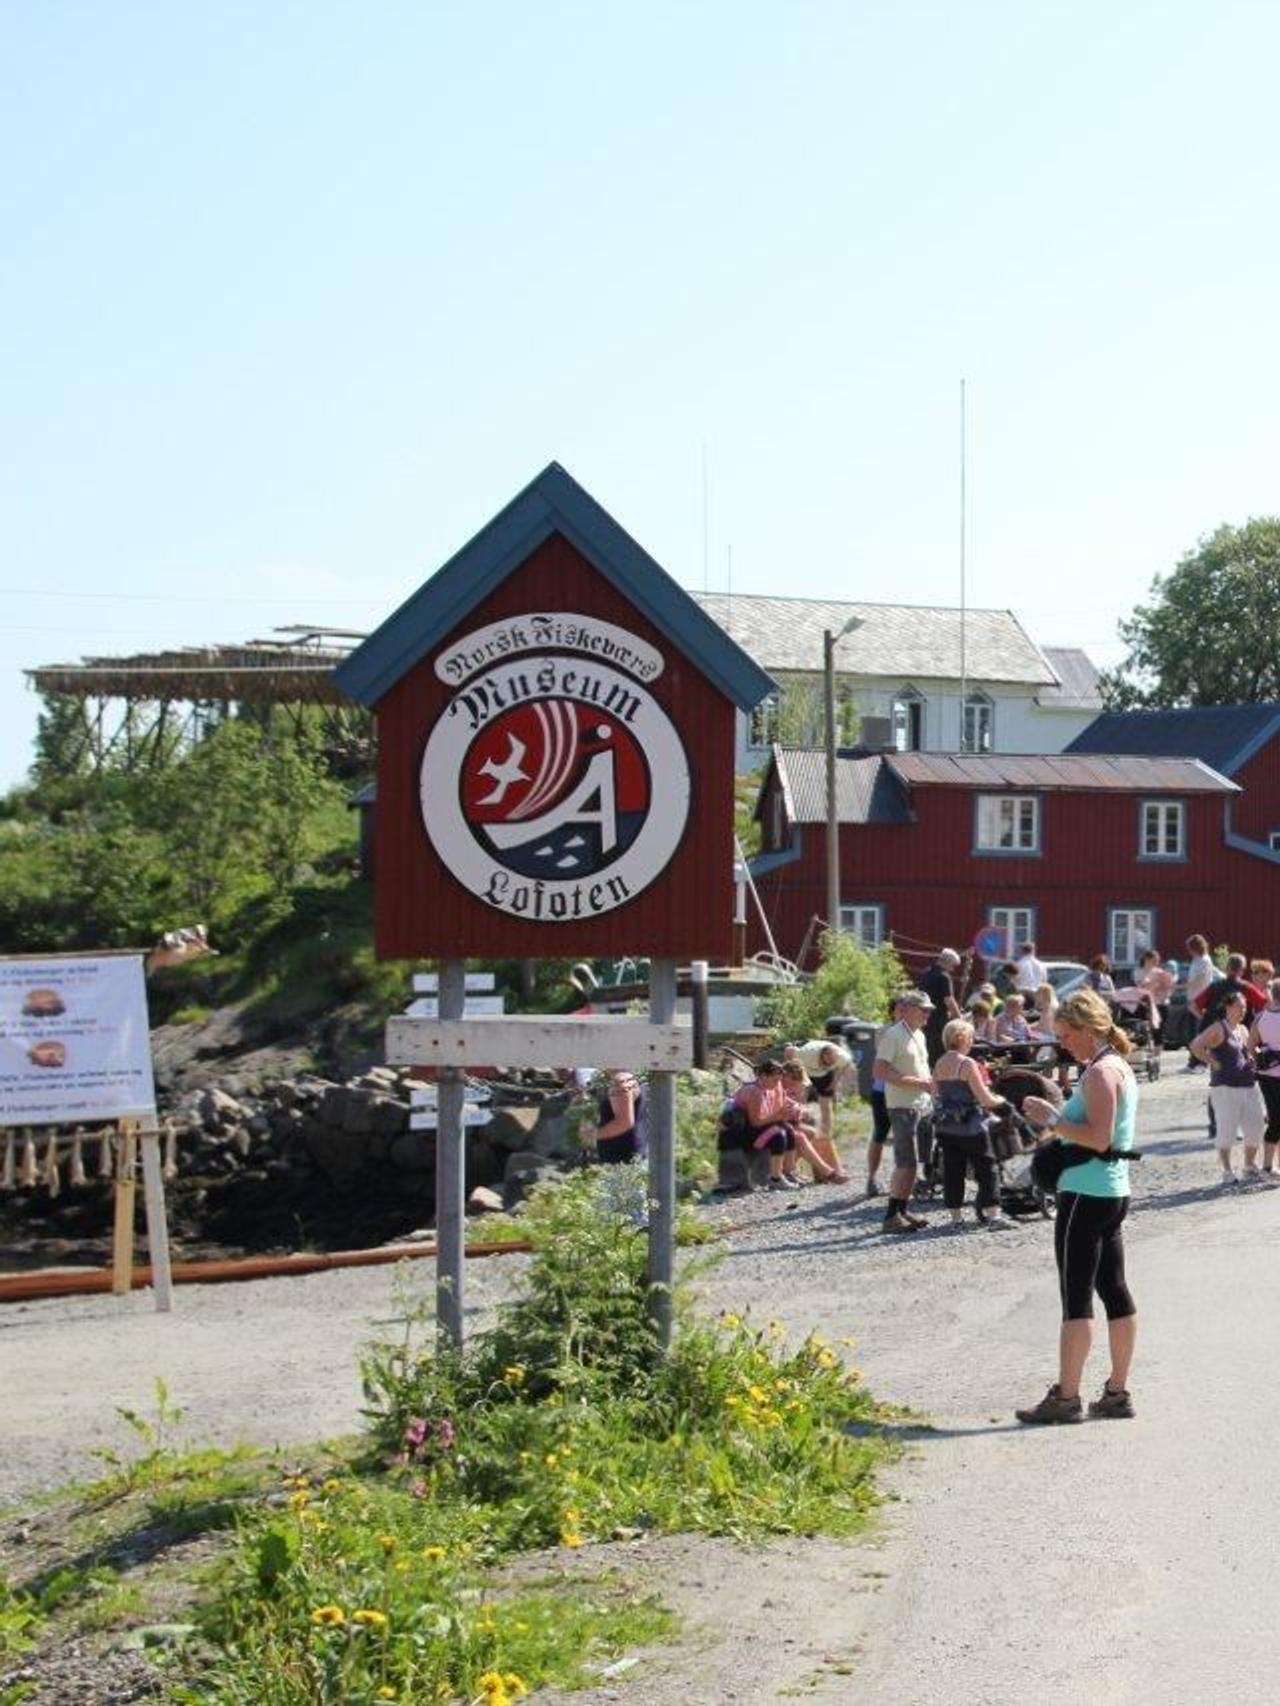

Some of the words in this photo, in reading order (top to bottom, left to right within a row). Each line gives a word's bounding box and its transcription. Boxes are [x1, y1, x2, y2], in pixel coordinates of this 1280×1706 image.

[445, 625, 528, 679] Norsk
[449, 660, 642, 729] Museum
[481, 870, 630, 918] Lofoten
